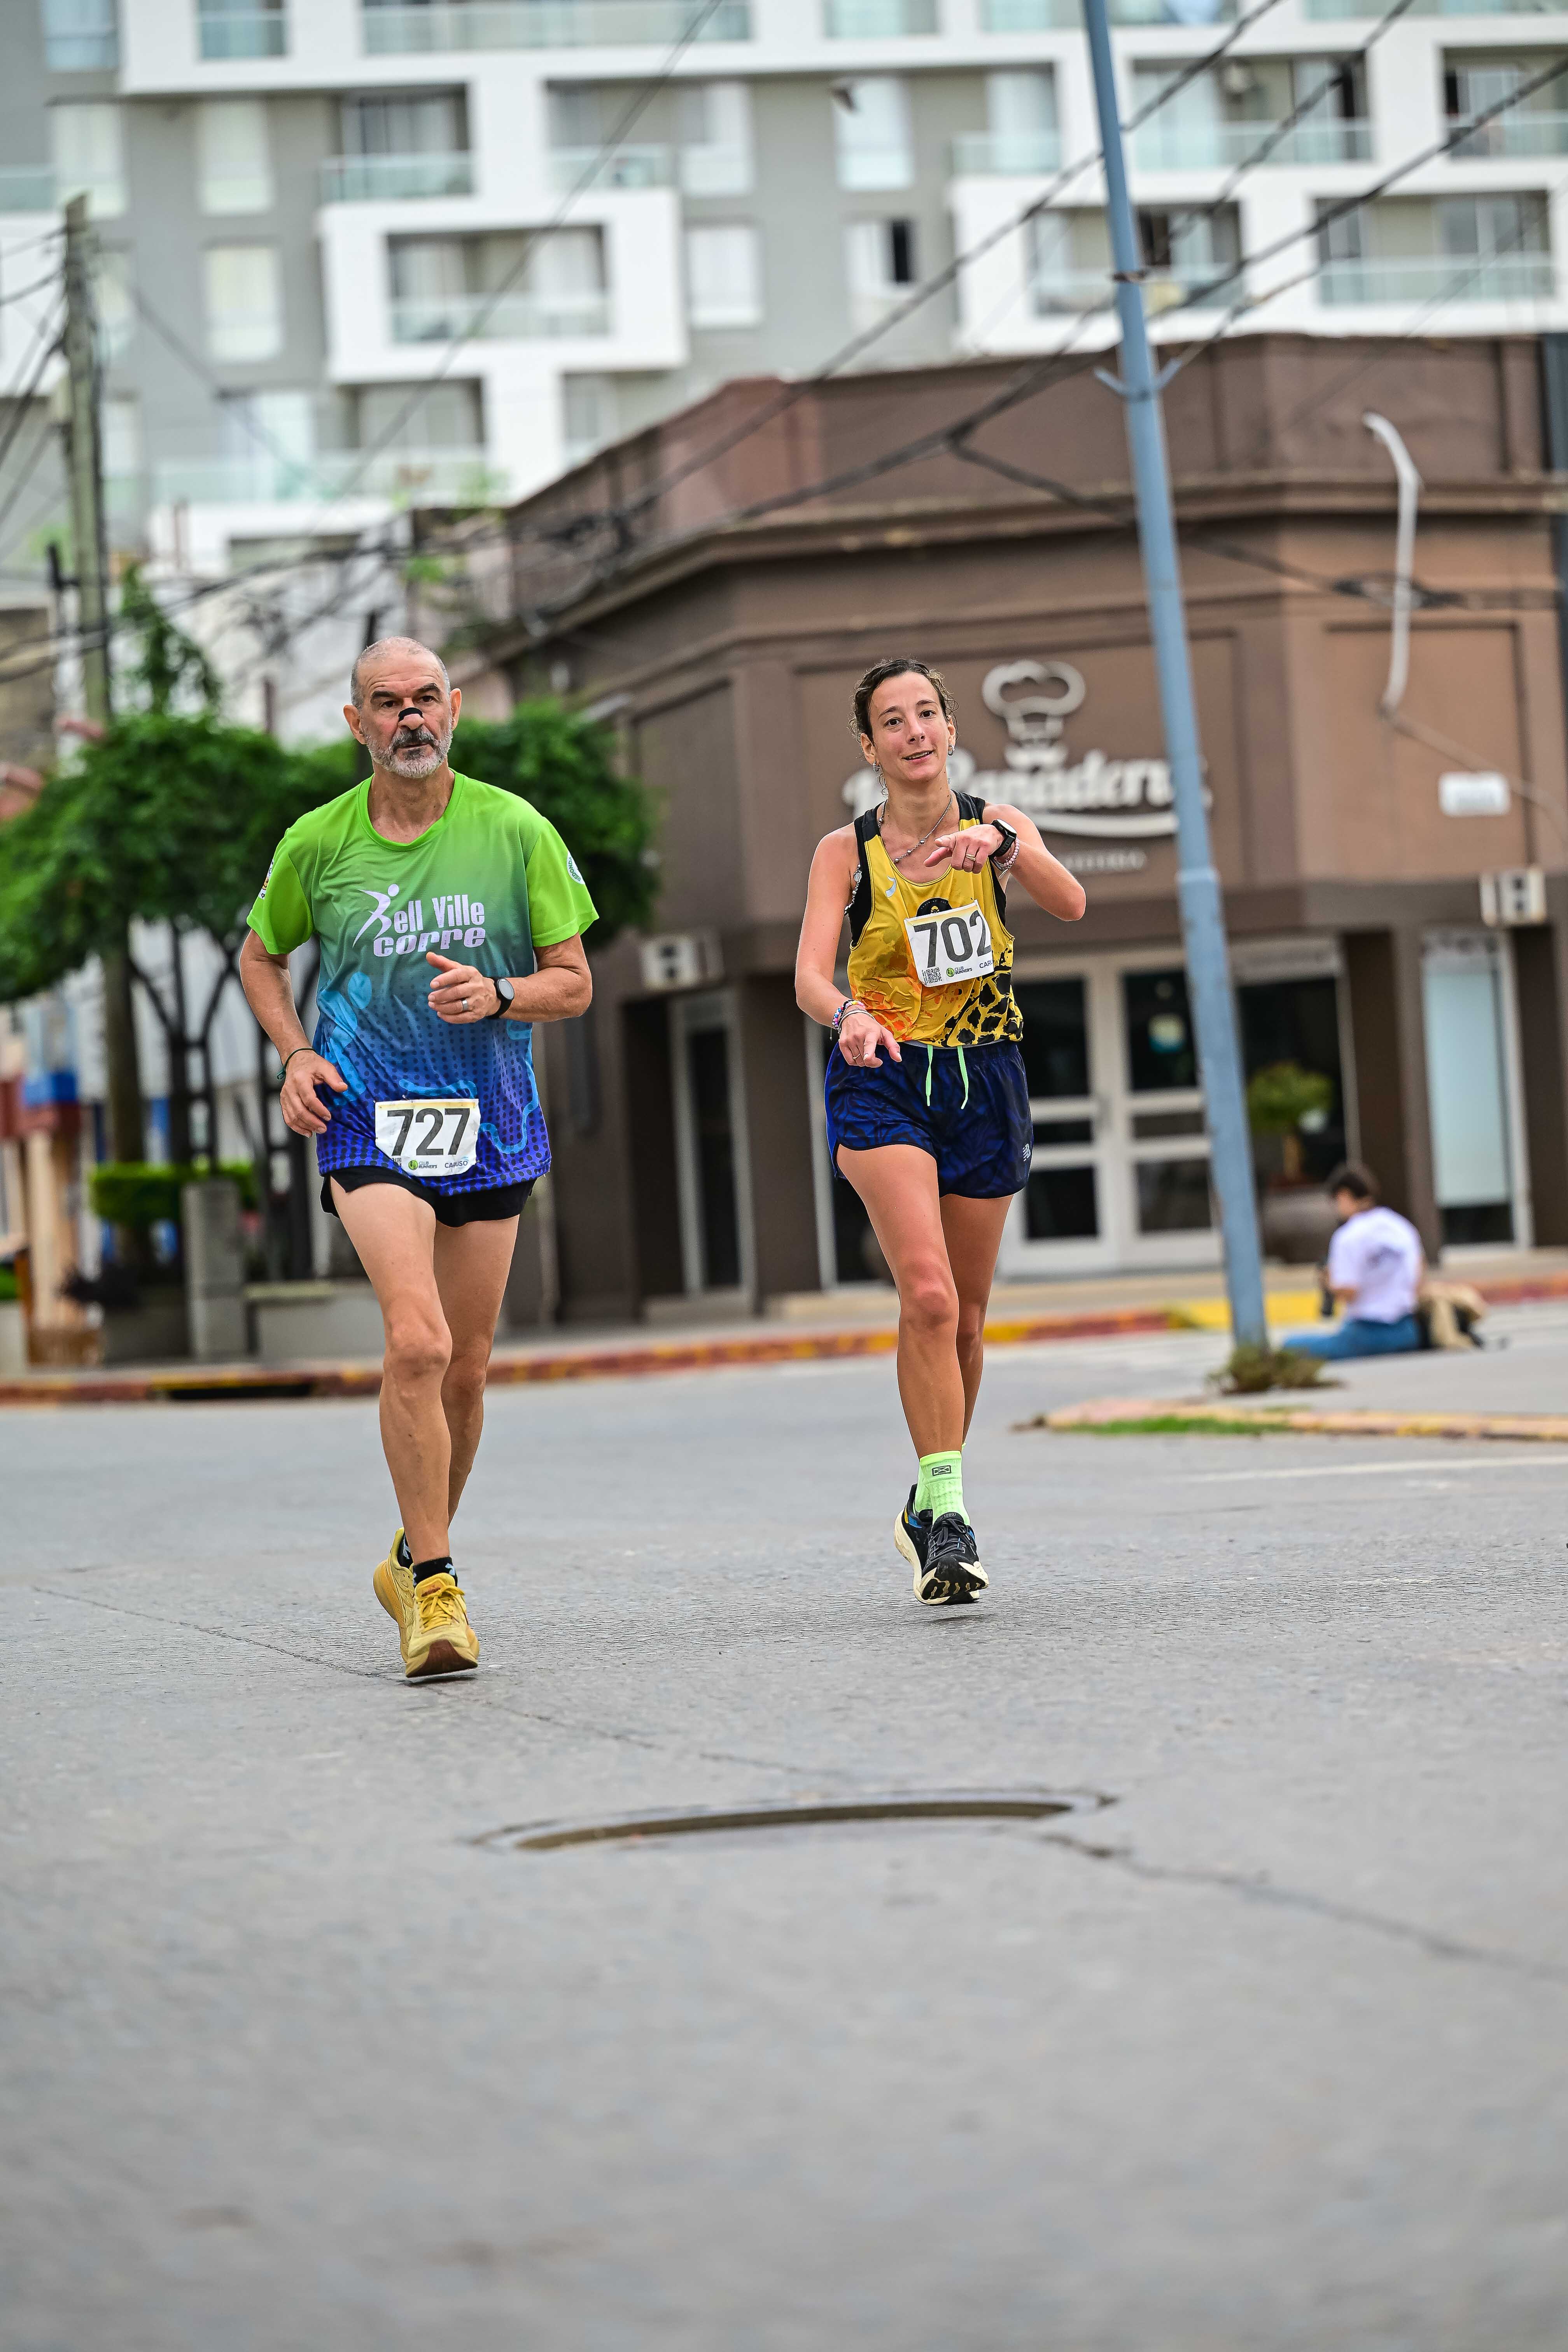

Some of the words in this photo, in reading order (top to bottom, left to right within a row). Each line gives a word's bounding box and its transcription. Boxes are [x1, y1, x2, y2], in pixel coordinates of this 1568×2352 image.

[432, 894, 485, 928] Ville
[373, 927, 486, 957] corre
[914, 910, 991, 968] 702
[387, 1108, 470, 1156] 727
